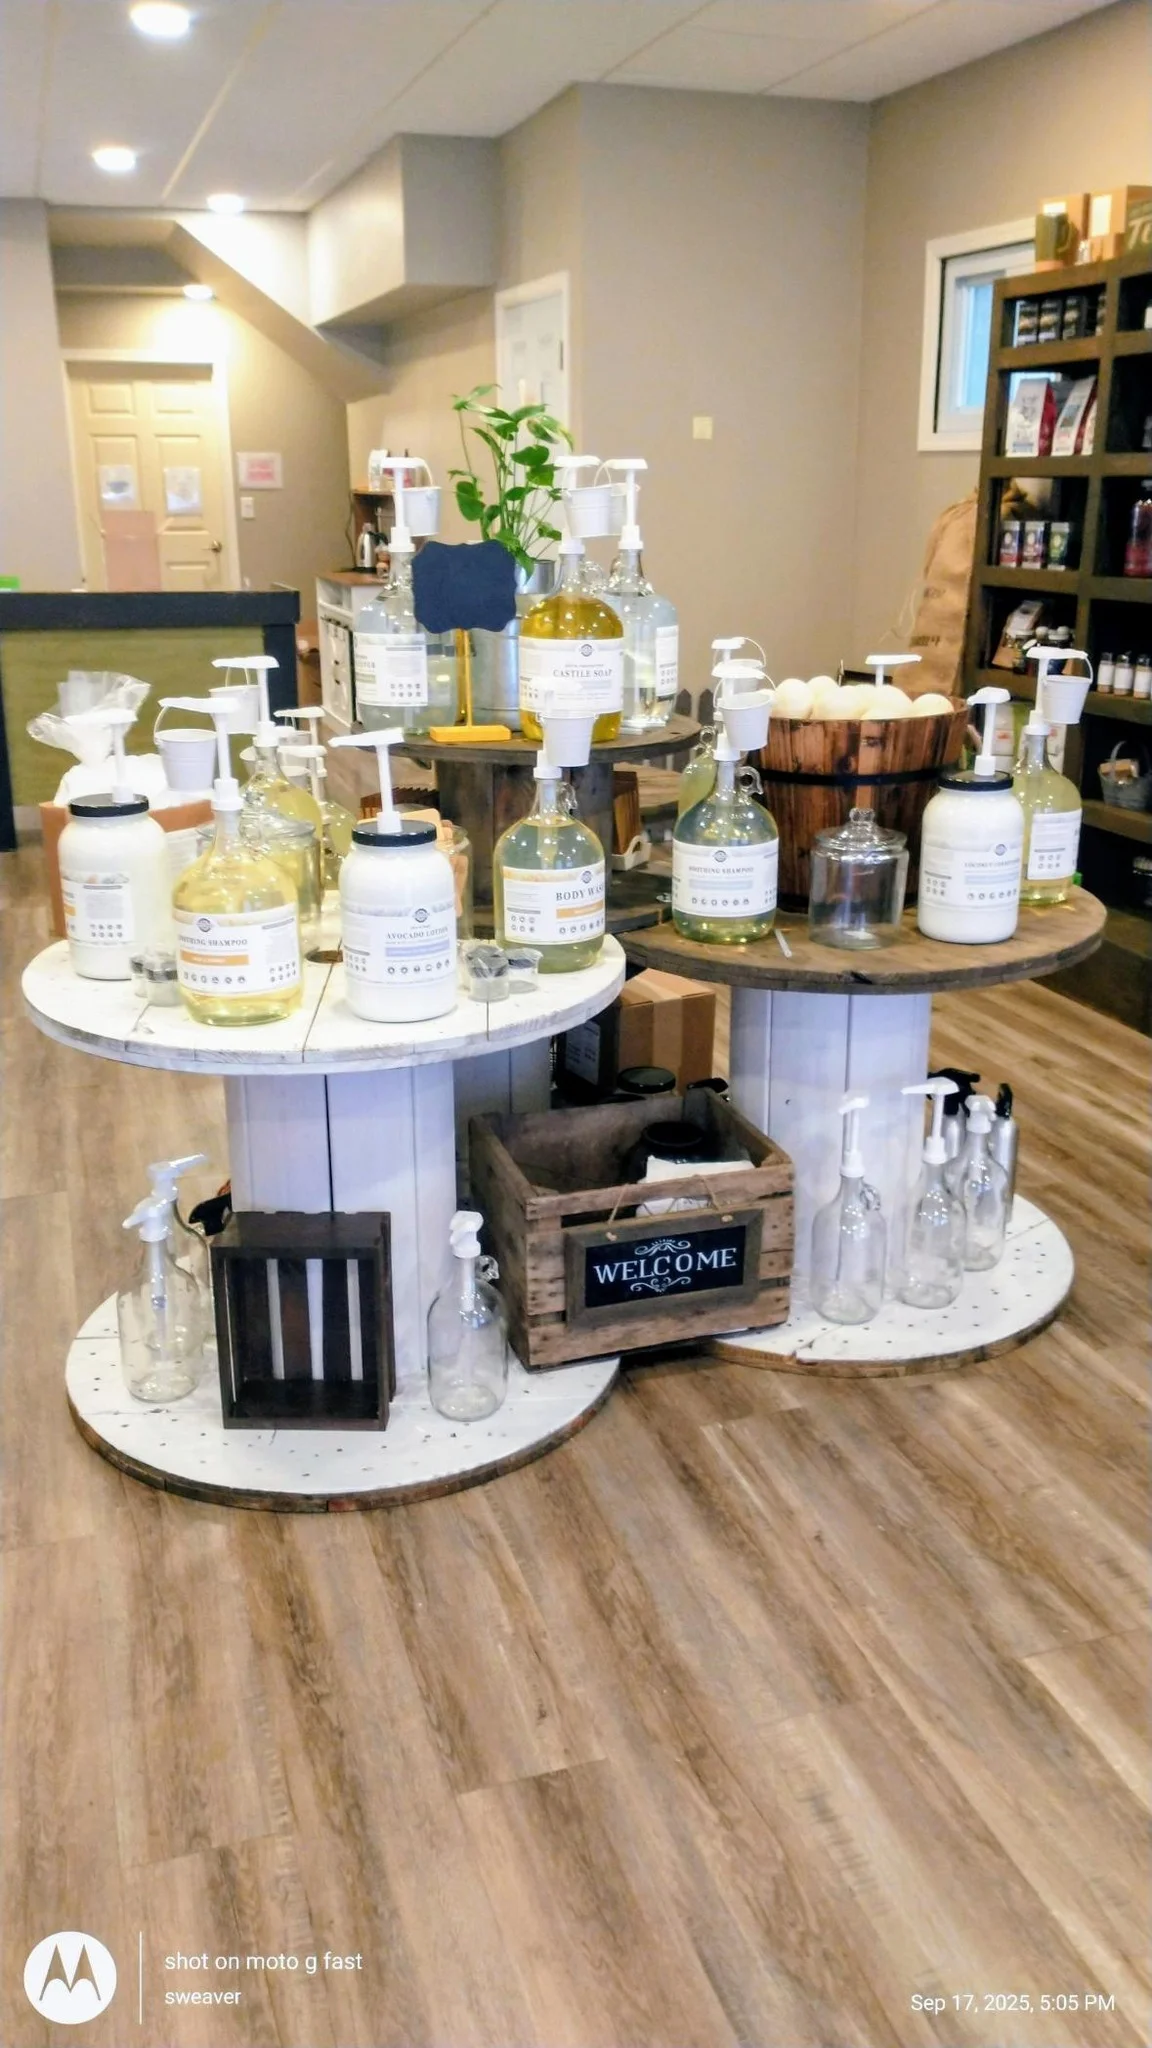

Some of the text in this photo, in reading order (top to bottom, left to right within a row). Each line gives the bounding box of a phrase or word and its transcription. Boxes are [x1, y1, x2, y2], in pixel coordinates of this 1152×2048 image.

[552, 669, 613, 678] CASTILE SOAP
[722, 866, 755, 875] SHAMPOO
[555, 883, 604, 902] BODY WAS
[386, 930, 425, 940] AVOCADO
[426, 925, 449, 937] LOTION
[208, 937, 248, 947] SHAMPOO
[592, 1247, 738, 1285] WELCOME
